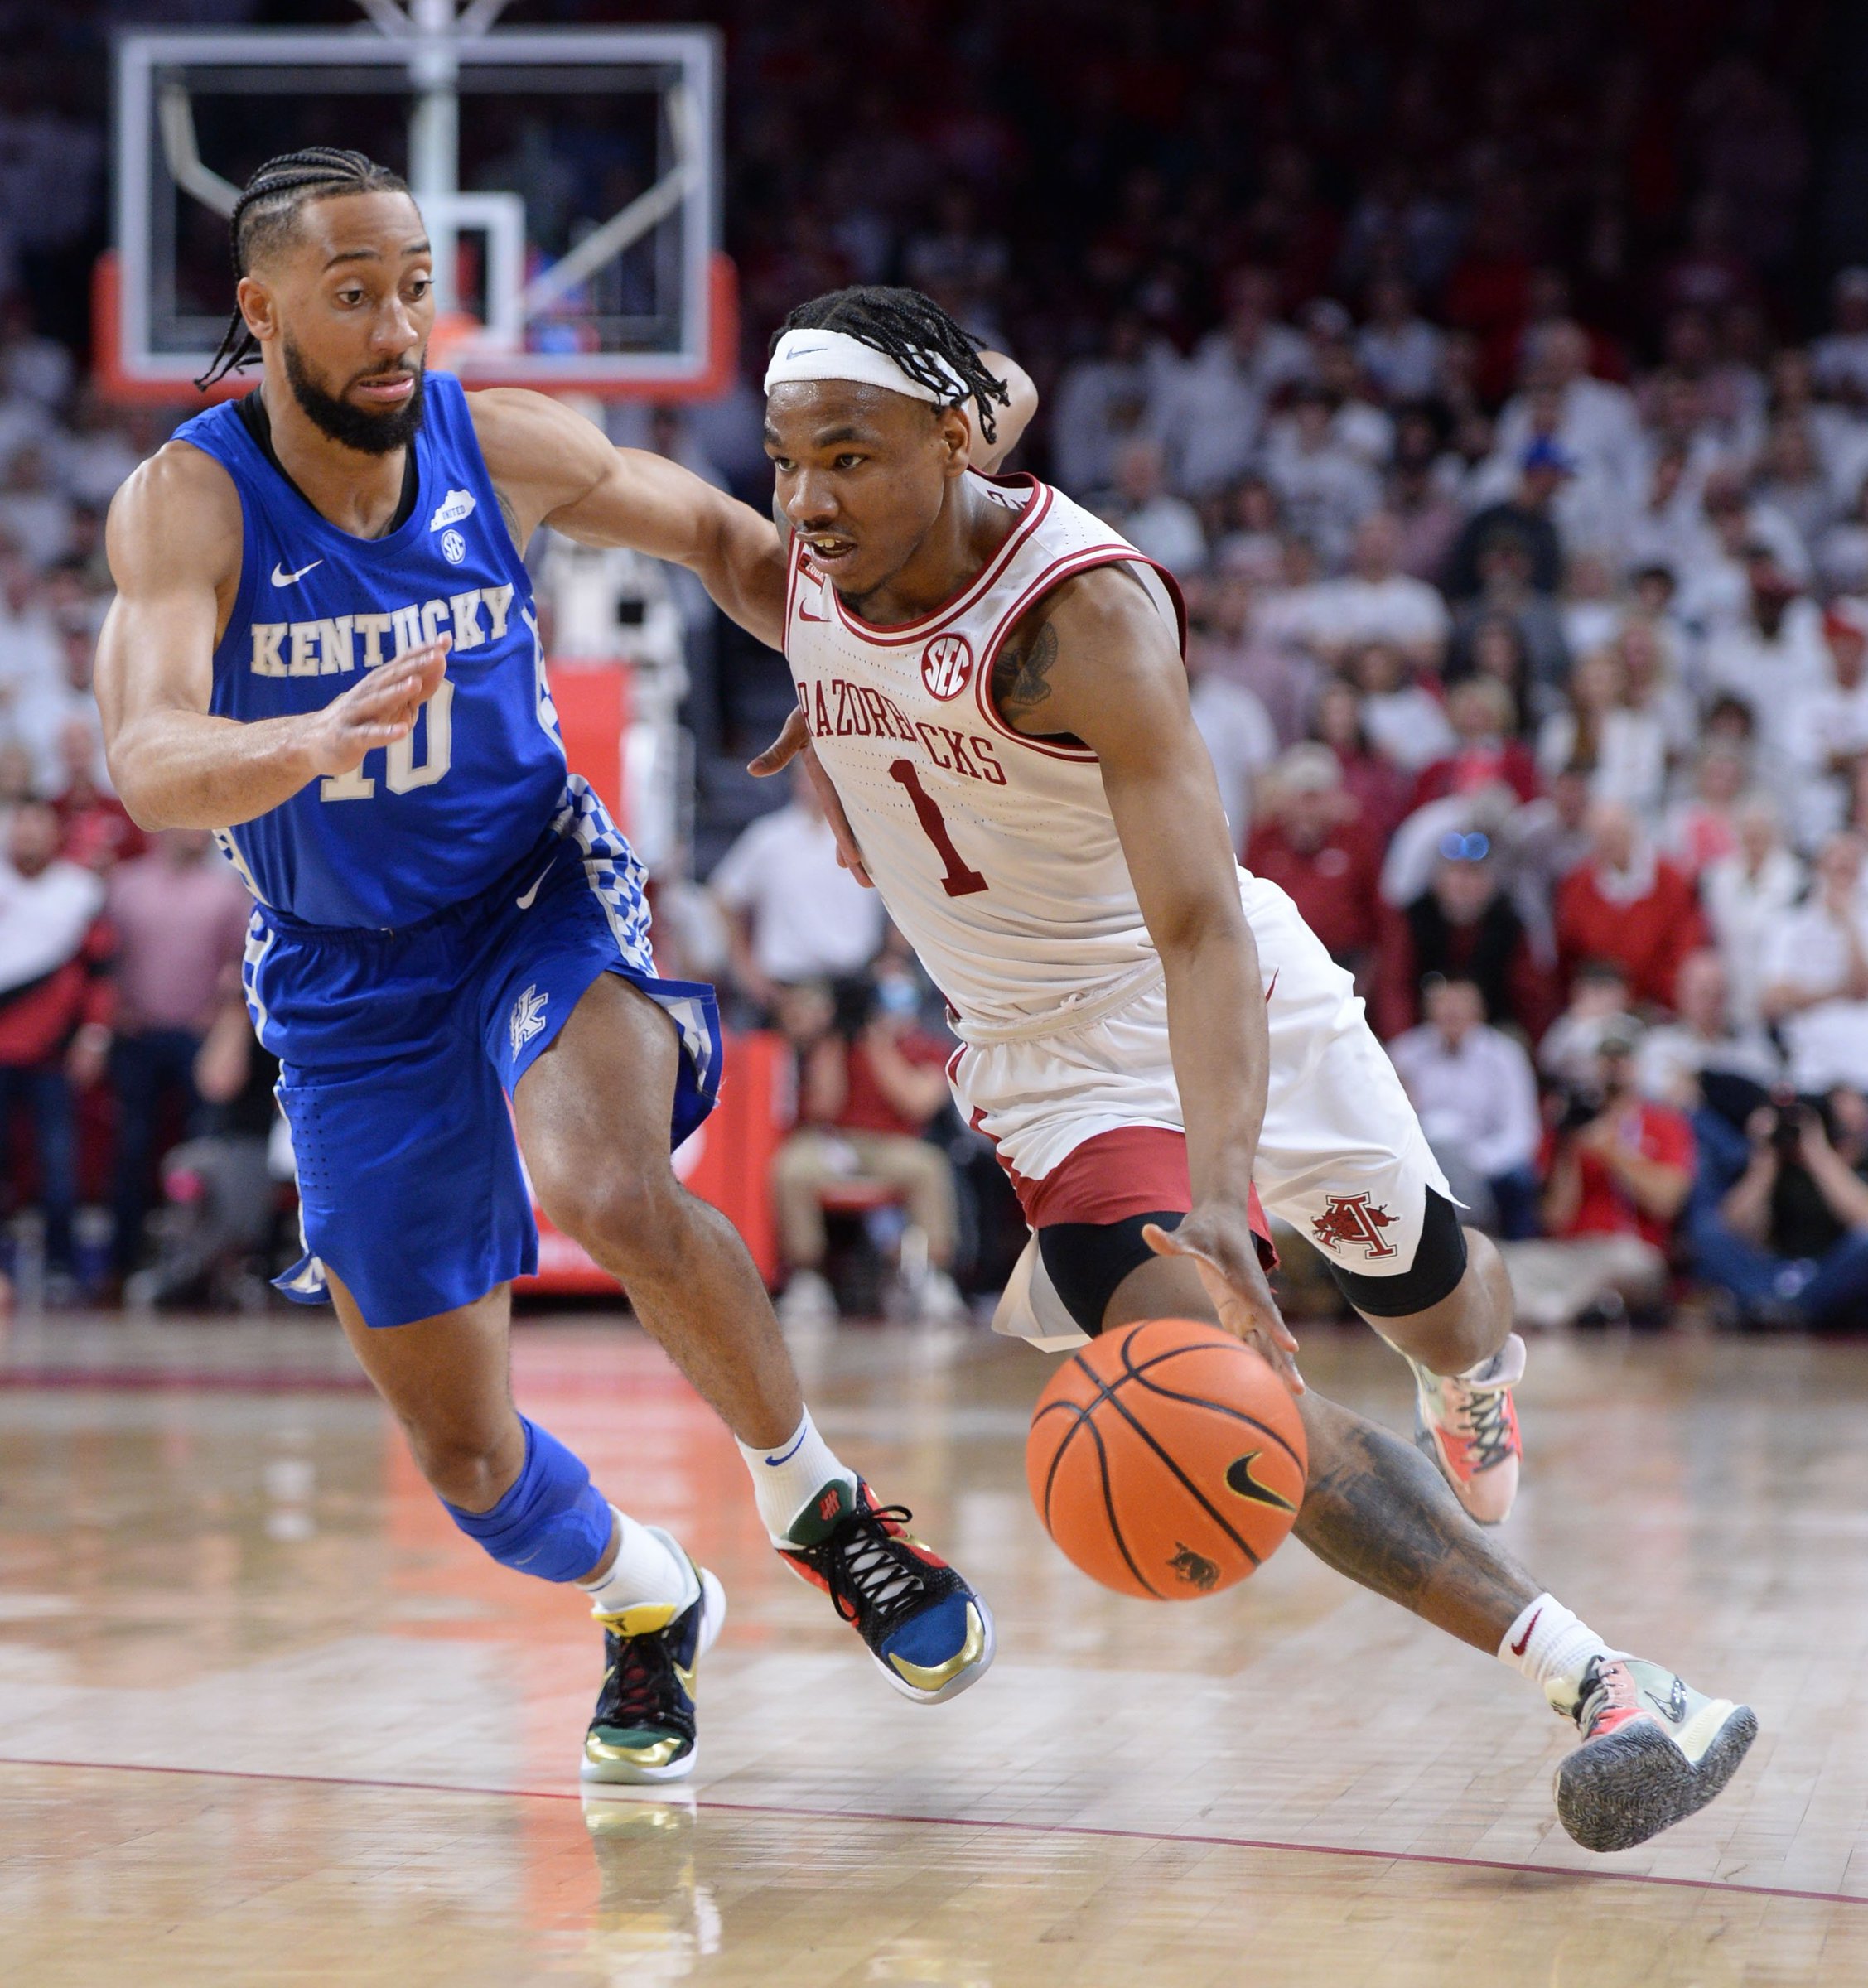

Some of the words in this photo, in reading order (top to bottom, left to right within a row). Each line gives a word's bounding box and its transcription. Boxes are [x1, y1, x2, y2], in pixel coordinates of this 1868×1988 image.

[442, 504, 466, 520] UNITED
[251, 582, 514, 678] KENTUCKY
[925, 638, 968, 699] SEC
[797, 679, 1007, 786] RAZORBCKS
[888, 759, 989, 897] 1
